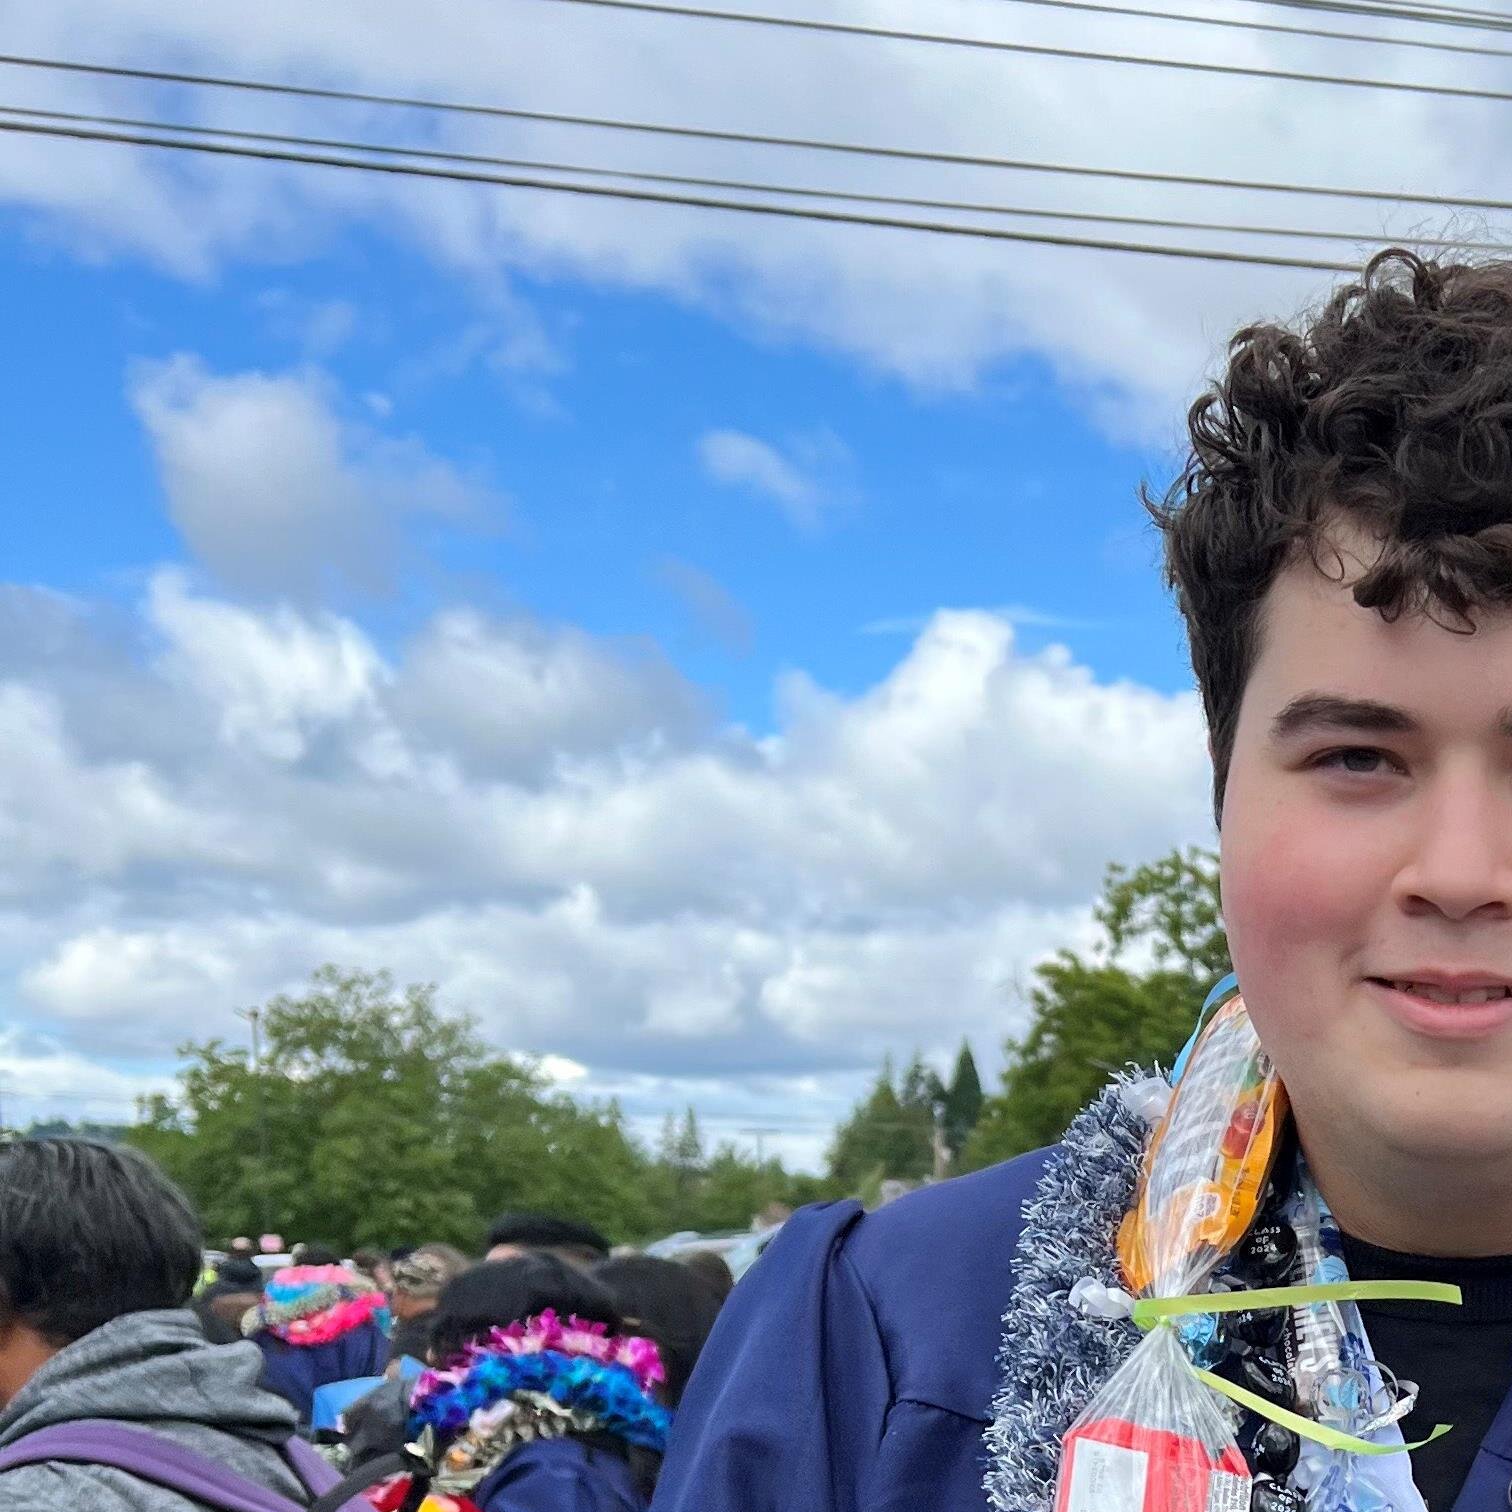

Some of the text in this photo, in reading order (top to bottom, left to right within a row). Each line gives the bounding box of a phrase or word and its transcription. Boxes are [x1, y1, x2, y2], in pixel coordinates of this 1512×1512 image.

[1255, 1236, 1270, 1245] OF
[1250, 1244, 1278, 1255] 2024
[1278, 1493, 1293, 1505] OF
